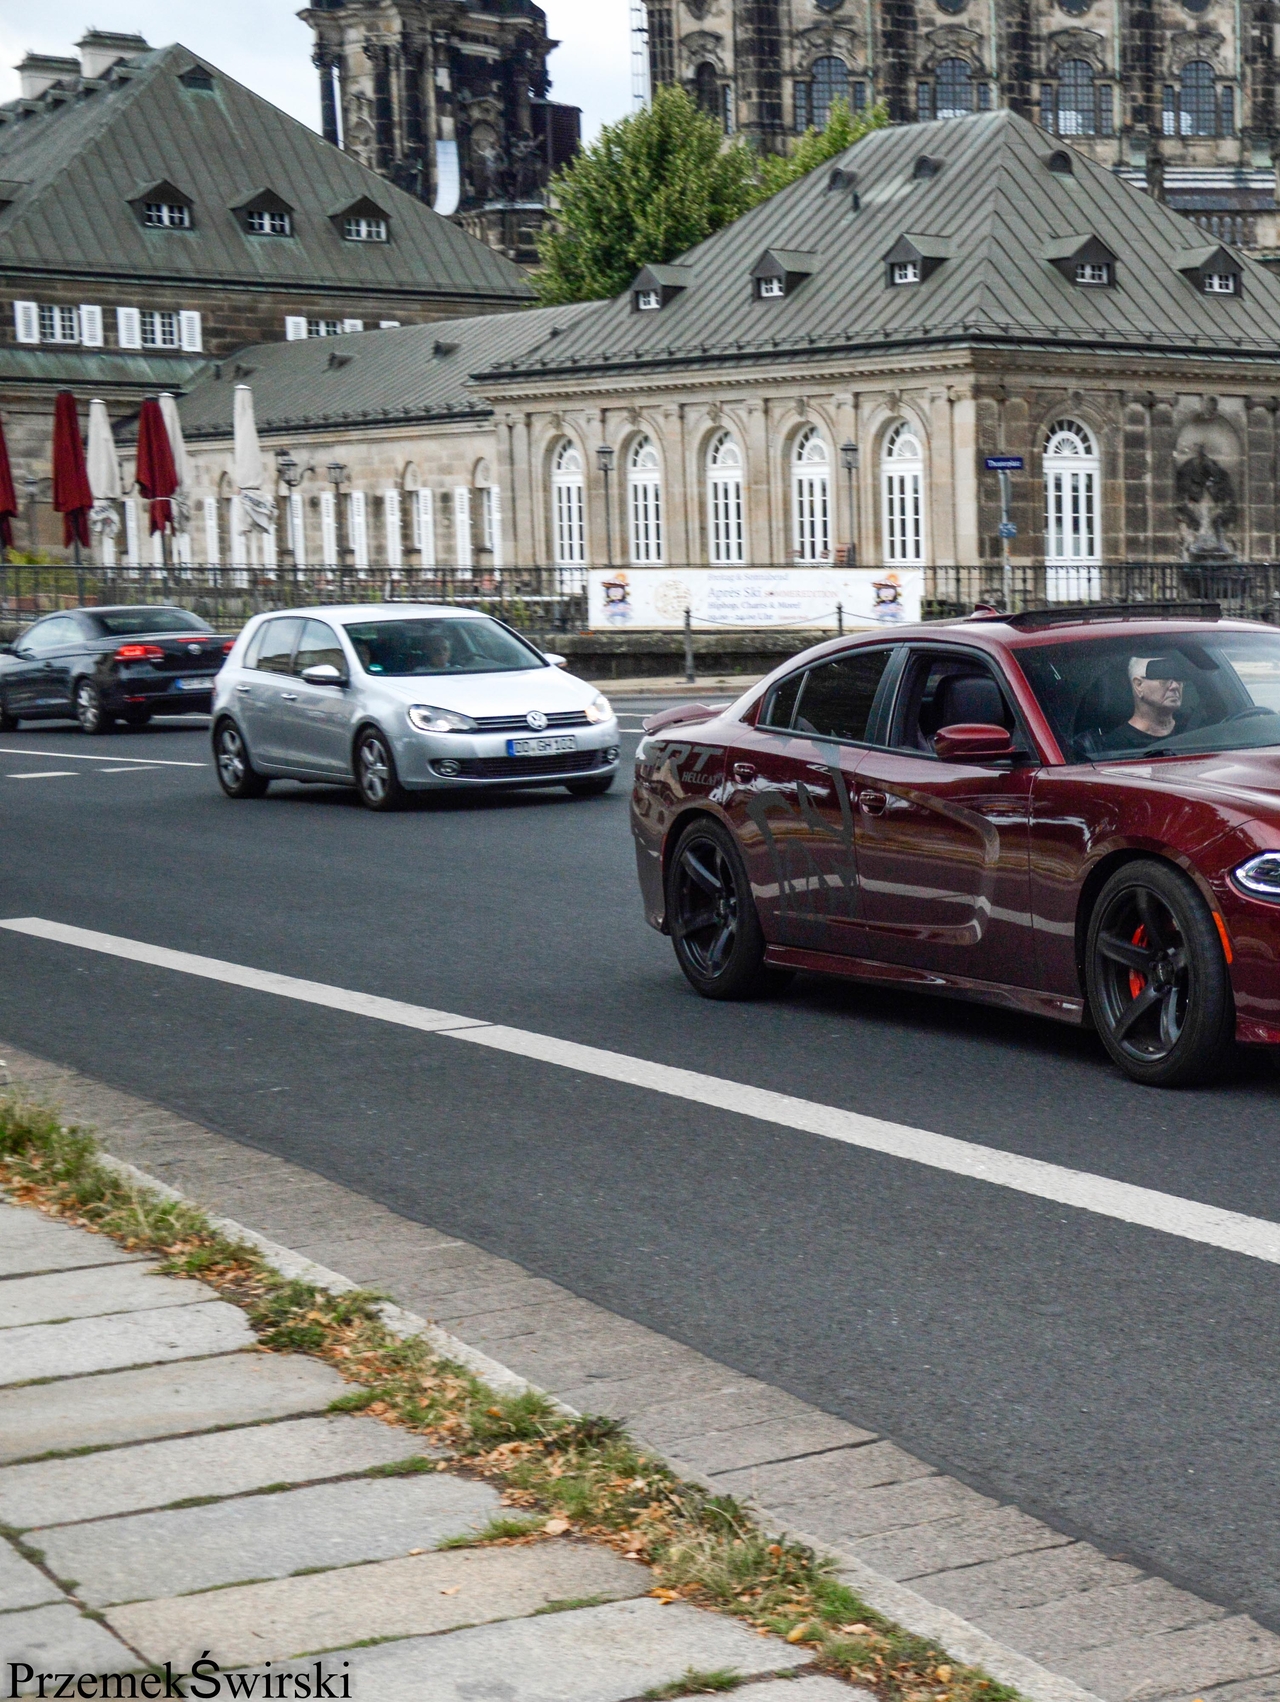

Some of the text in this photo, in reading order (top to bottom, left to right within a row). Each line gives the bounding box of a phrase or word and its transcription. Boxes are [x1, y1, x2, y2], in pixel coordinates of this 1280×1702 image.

[743, 586, 761, 597] Ski
[635, 741, 725, 783] SRT
[681, 771, 723, 787] HELLCAT
